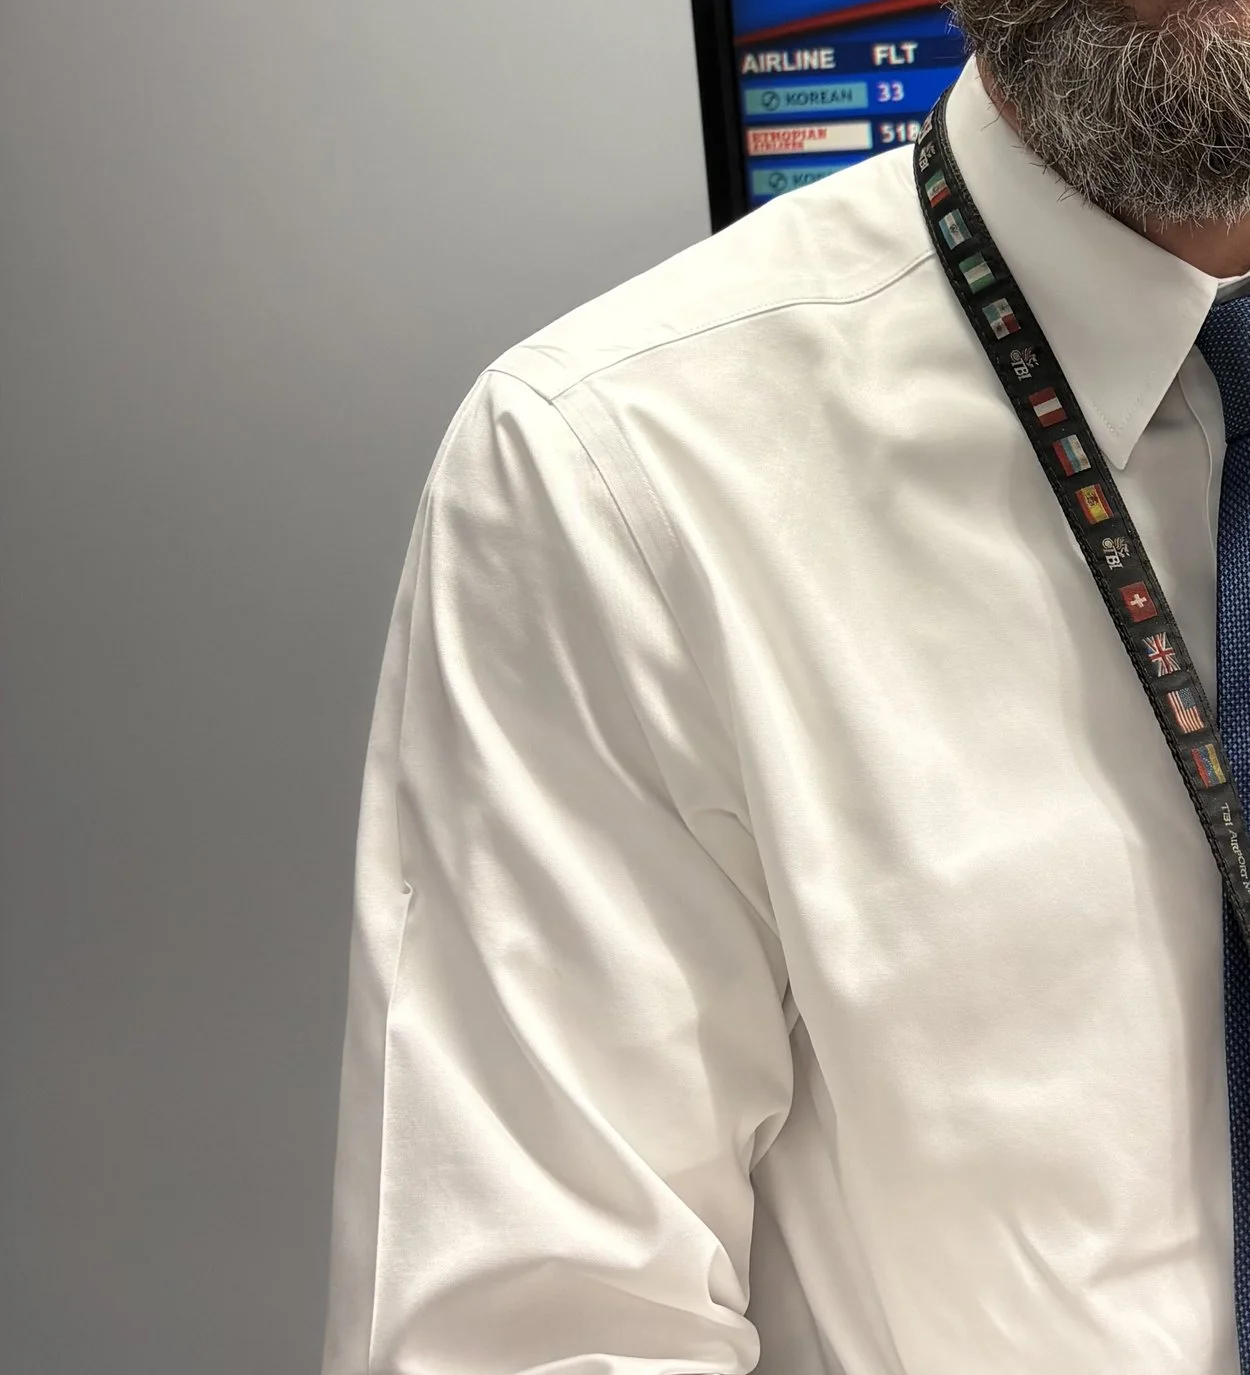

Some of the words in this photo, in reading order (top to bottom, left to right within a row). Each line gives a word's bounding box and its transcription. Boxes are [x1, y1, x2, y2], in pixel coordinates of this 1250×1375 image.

[741, 46, 836, 75] AIRLINE
[872, 43, 918, 66] FLT
[785, 89, 853, 106] KOREAN
[877, 82, 904, 102] 33
[1102, 546, 1124, 571] TBI
[1221, 802, 1234, 827] TBI
[1228, 828, 1248, 879] AIRPORT
